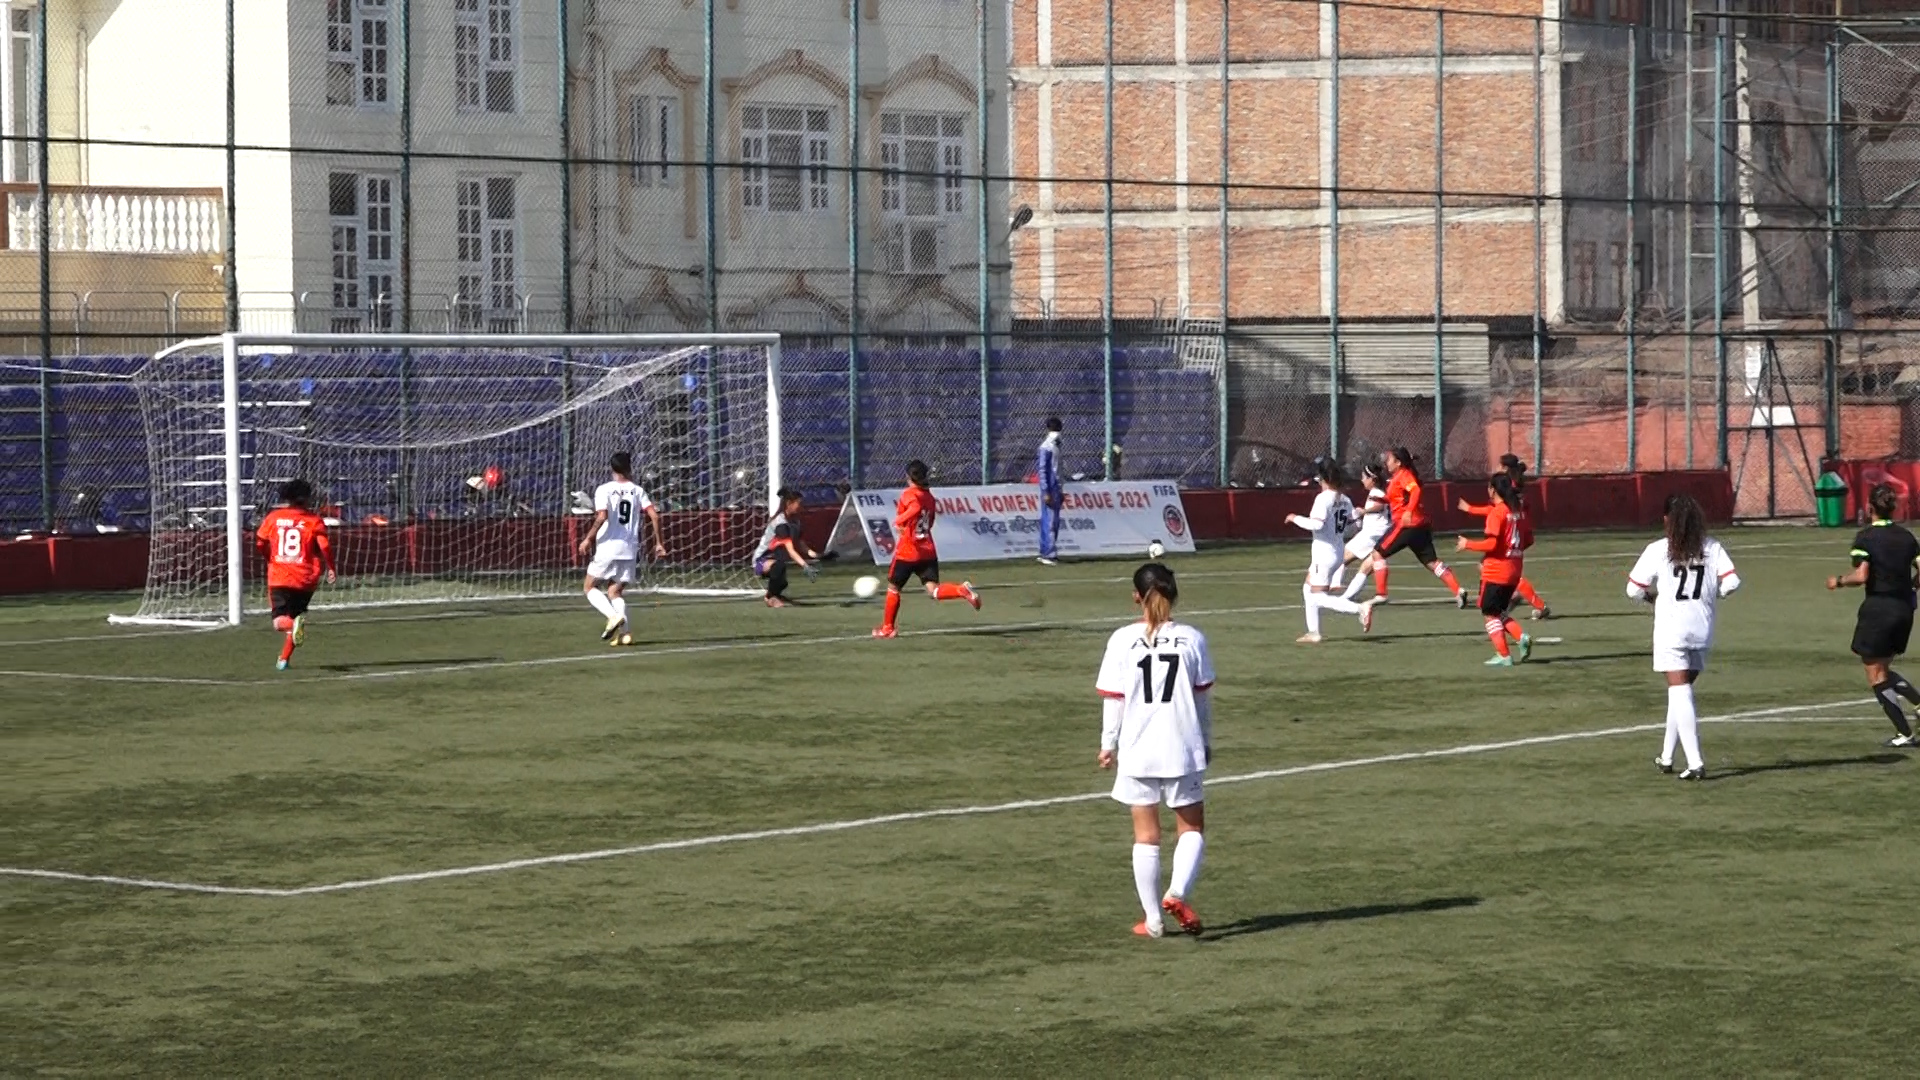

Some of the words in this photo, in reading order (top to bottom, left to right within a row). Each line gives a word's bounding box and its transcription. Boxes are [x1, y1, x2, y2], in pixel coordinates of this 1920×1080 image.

[857, 495, 885, 507] FIFA
[1117, 491, 1152, 508] 2021
[1152, 485, 1177, 496] FIFA
[618, 498, 632, 525] 9
[1334, 509, 1348, 534] 15
[277, 528, 301, 557] 18
[1673, 564, 1705, 601] 27
[1136, 653, 1180, 704] 17
